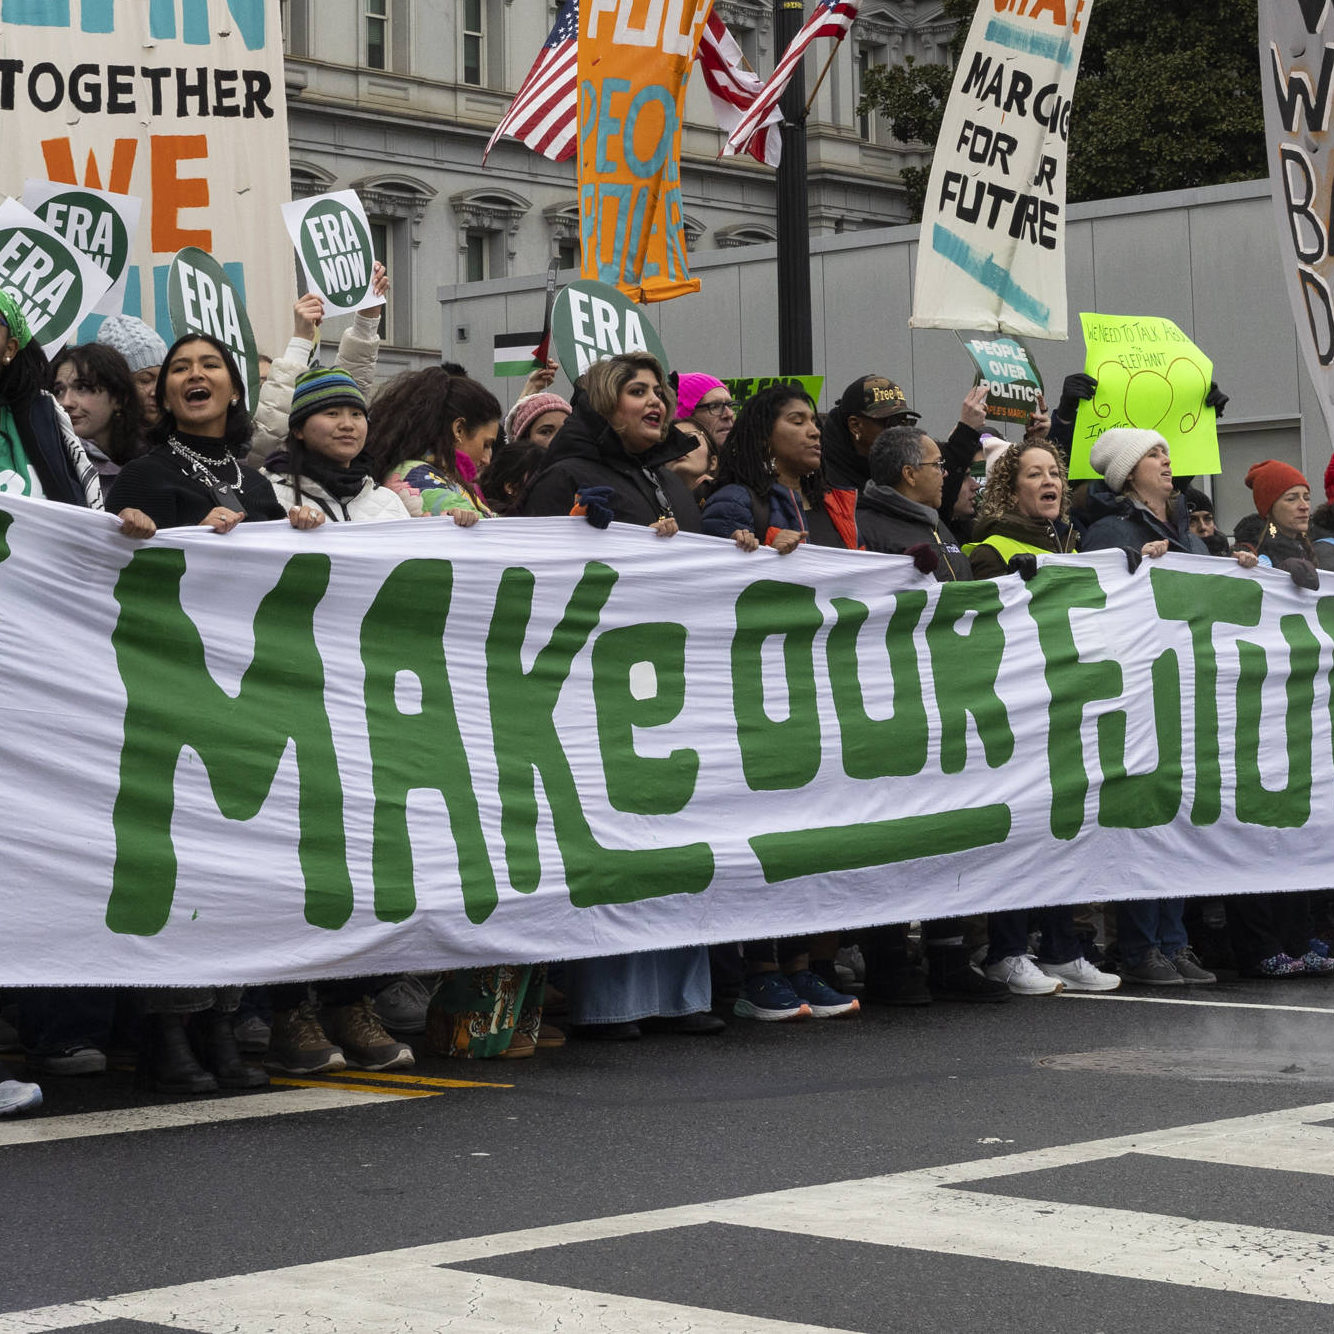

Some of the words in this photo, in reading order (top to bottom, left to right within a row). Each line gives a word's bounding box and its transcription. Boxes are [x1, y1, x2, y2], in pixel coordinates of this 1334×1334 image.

[957, 119, 1018, 175] FOR
[41, 134, 212, 254] WE
[45, 202, 113, 255] ERA
[305, 210, 361, 258] ERA
[320, 251, 366, 296] NOW
[177, 259, 245, 353] ERA
[568, 288, 648, 354] ERA
[971, 339, 1028, 362] PEOPLE
[1098, 323, 1122, 343] NEED
[989, 360, 1027, 380] OVER
[1118, 352, 1167, 369] ELEPHANT
[873, 387, 894, 402] Free
[980, 378, 1042, 403] POLITICS
[734, 578, 1015, 791] OUR
